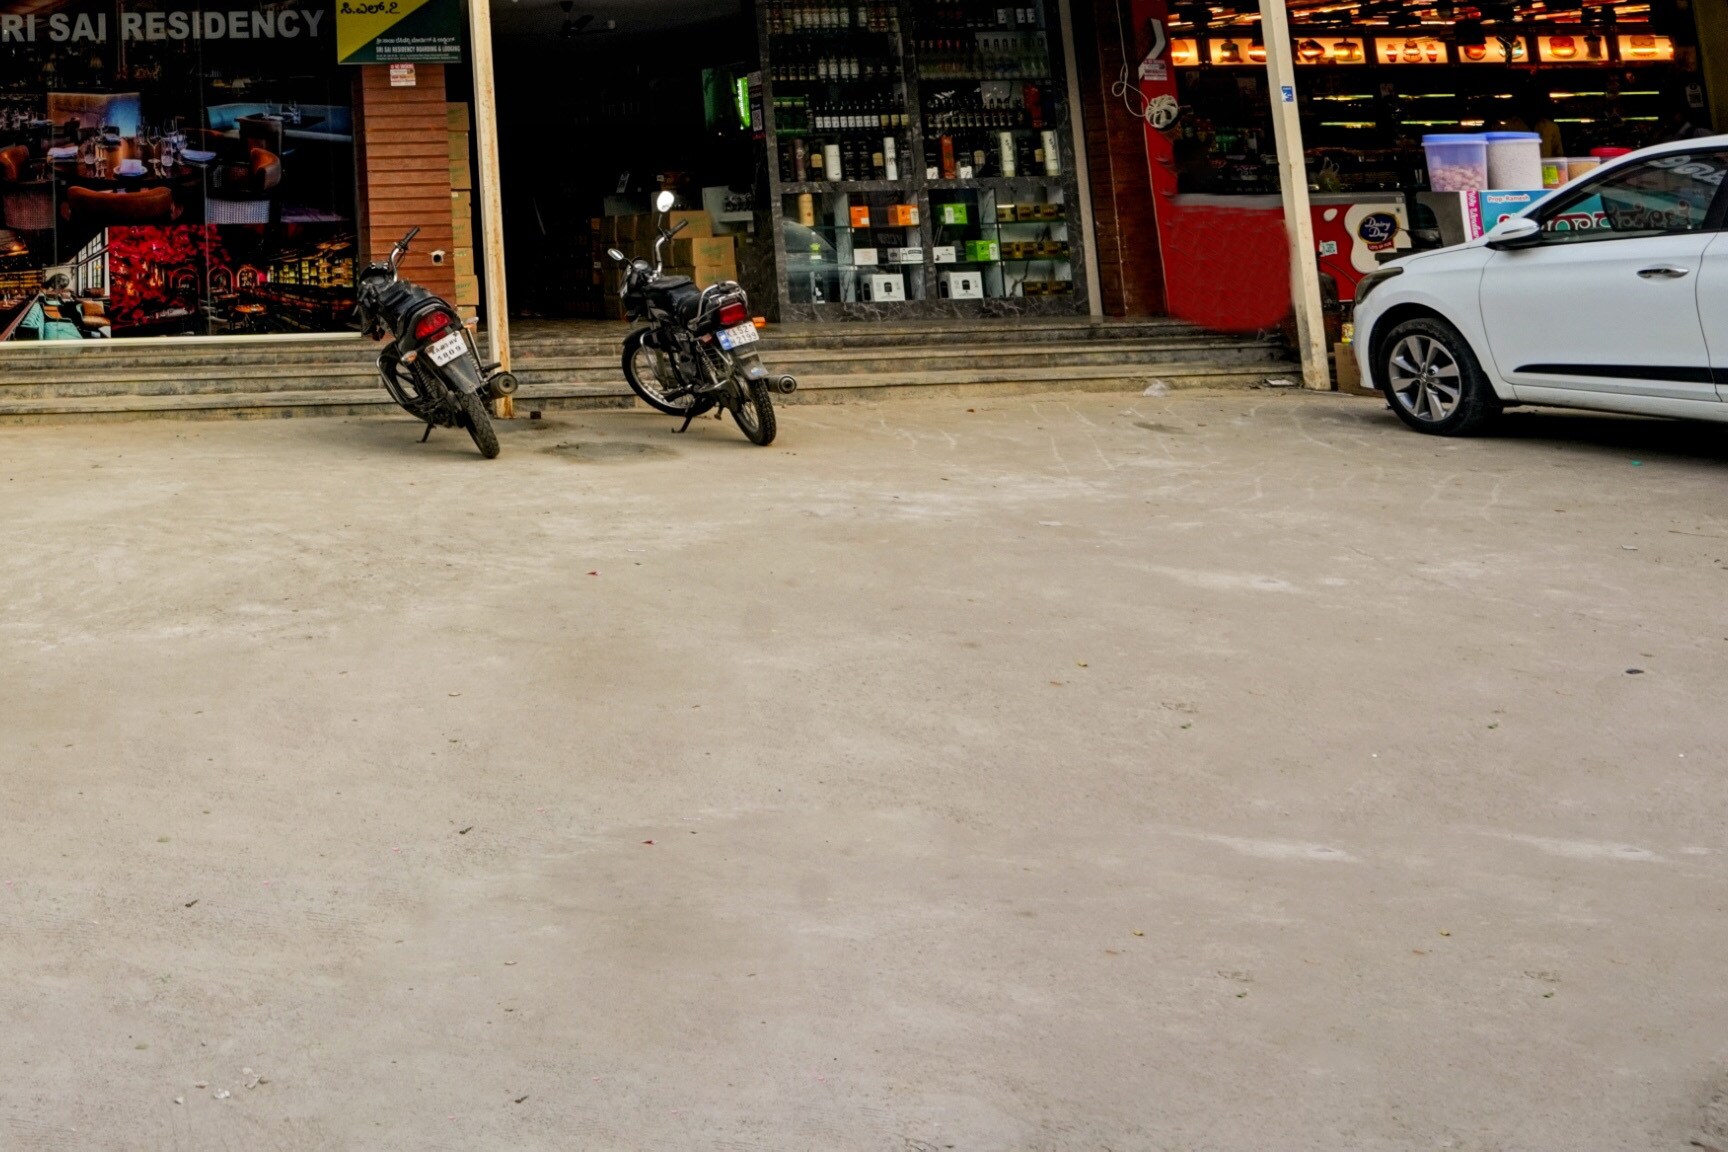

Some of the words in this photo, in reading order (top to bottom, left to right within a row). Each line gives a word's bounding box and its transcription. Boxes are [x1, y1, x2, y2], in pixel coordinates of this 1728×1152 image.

[48, 11, 107, 42] SAI
[121, 9, 325, 41] RESIDENCY
[1364, 217, 1391, 231] Dairy
[1368, 226, 1389, 241] Day
